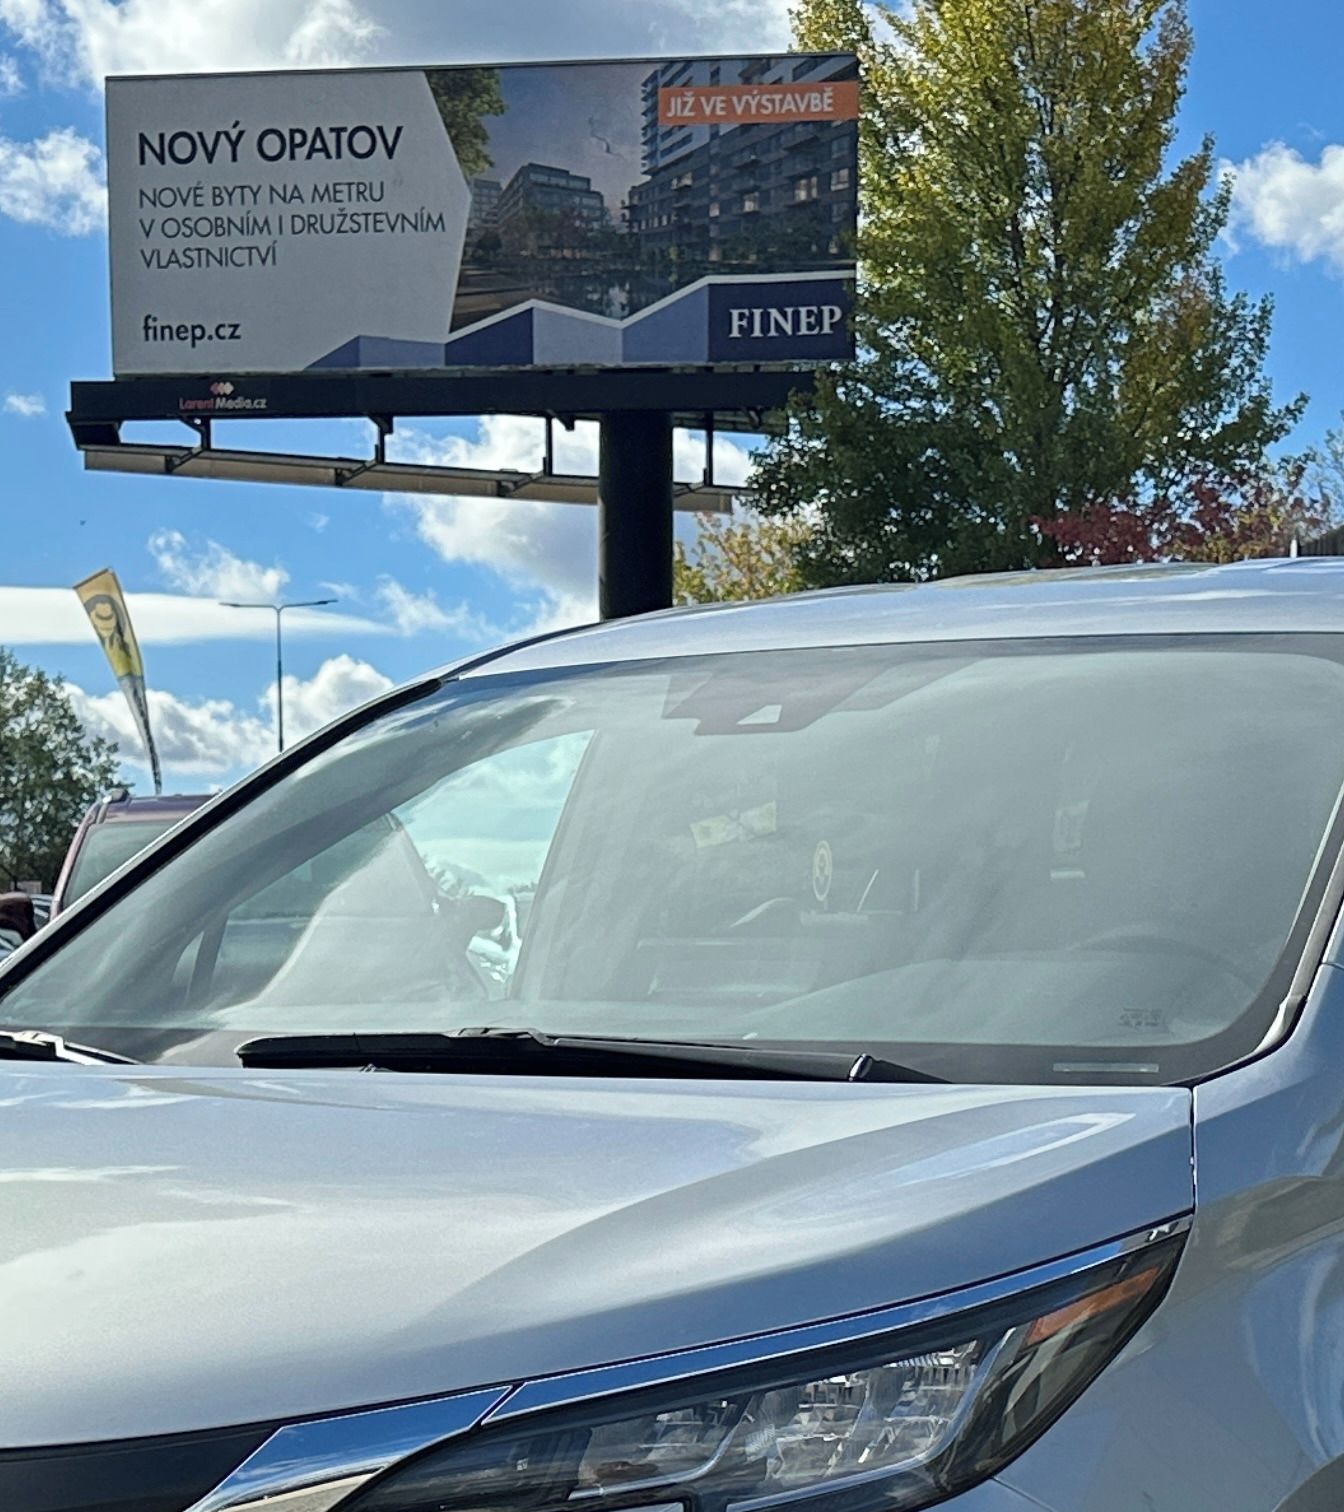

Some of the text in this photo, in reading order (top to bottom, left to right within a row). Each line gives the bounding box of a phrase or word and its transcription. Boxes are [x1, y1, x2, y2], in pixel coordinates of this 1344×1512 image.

[666, 87, 834, 118] JIŽ VE VÝSTAVBĚ
[138, 120, 404, 166] NOVÝ OPATOV
[139, 181, 385, 209] NOVÉ BYTY NA METRU
[139, 207, 446, 239] V OSOBNÍM I DRUŽSTEVNÍM
[140, 240, 278, 270] VLASTNICTVÍ
[142, 313, 241, 348] finep.cz
[728, 304, 843, 338] FINEP
